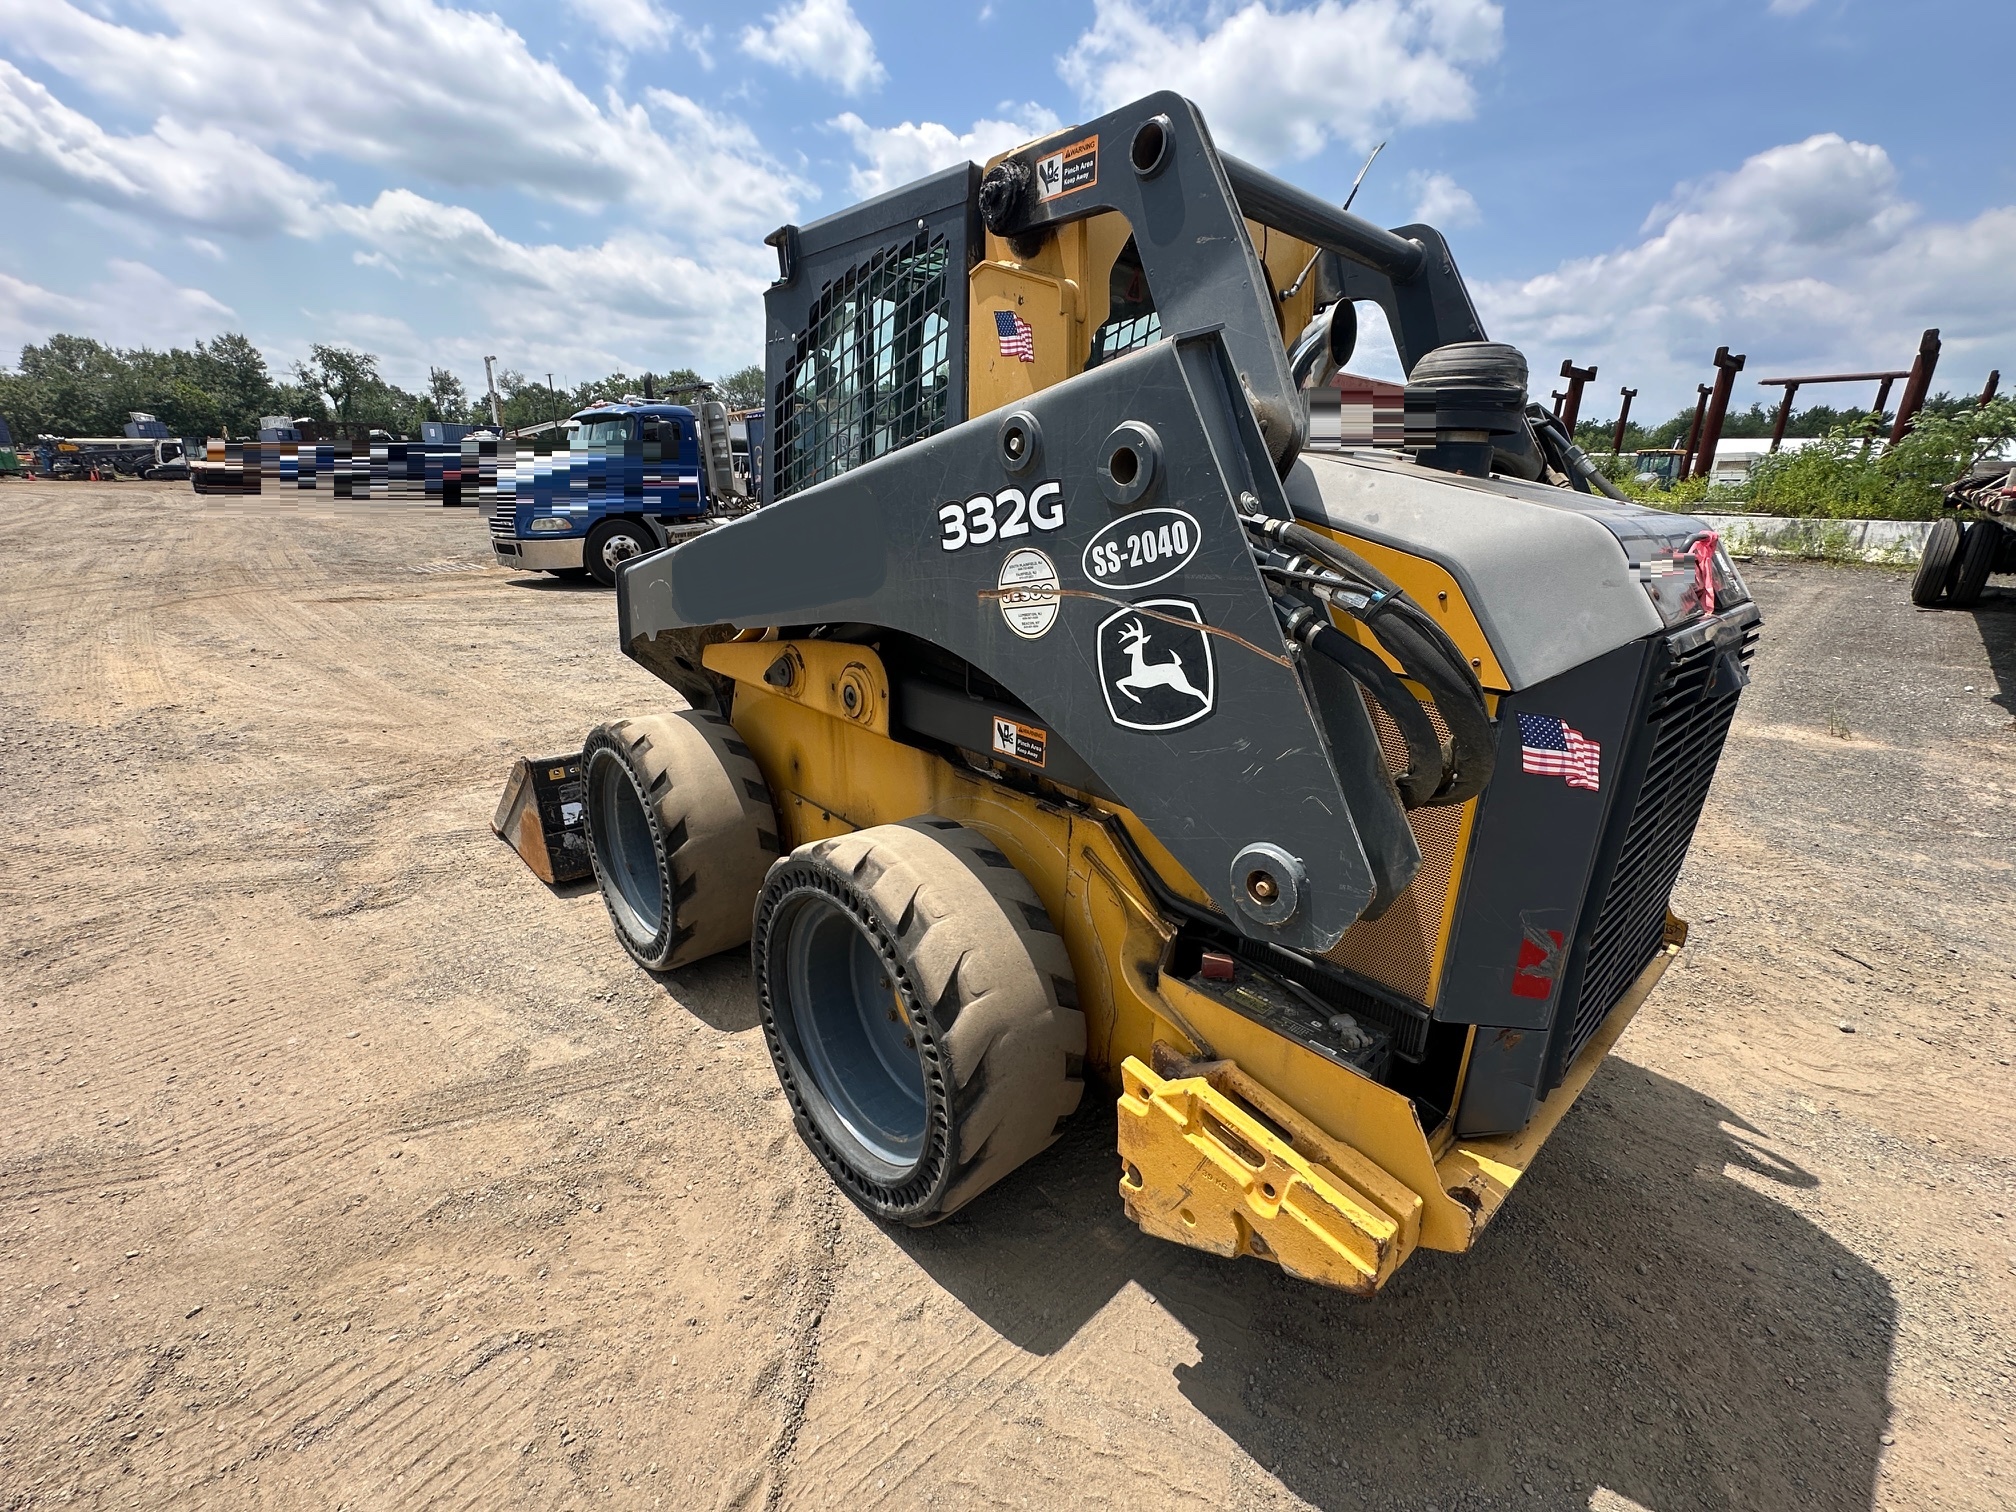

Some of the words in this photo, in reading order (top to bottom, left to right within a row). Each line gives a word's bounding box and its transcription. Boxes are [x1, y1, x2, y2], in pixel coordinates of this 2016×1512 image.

[1070, 141, 1095, 155] WARNING
[1064, 164, 1079, 176] Pinch
[1080, 160, 1093, 170] Area
[1064, 177, 1075, 185] Keep
[1076, 172, 1089, 181] Away
[938, 482, 1065, 550] 332G
[1092, 520, 1189, 577] SS-2040
[1022, 729, 1043, 739] WARNING
[1017, 738, 1030, 748] Pinch
[1017, 747, 1027, 755] Keep
[1027, 750, 1039, 758] Away
